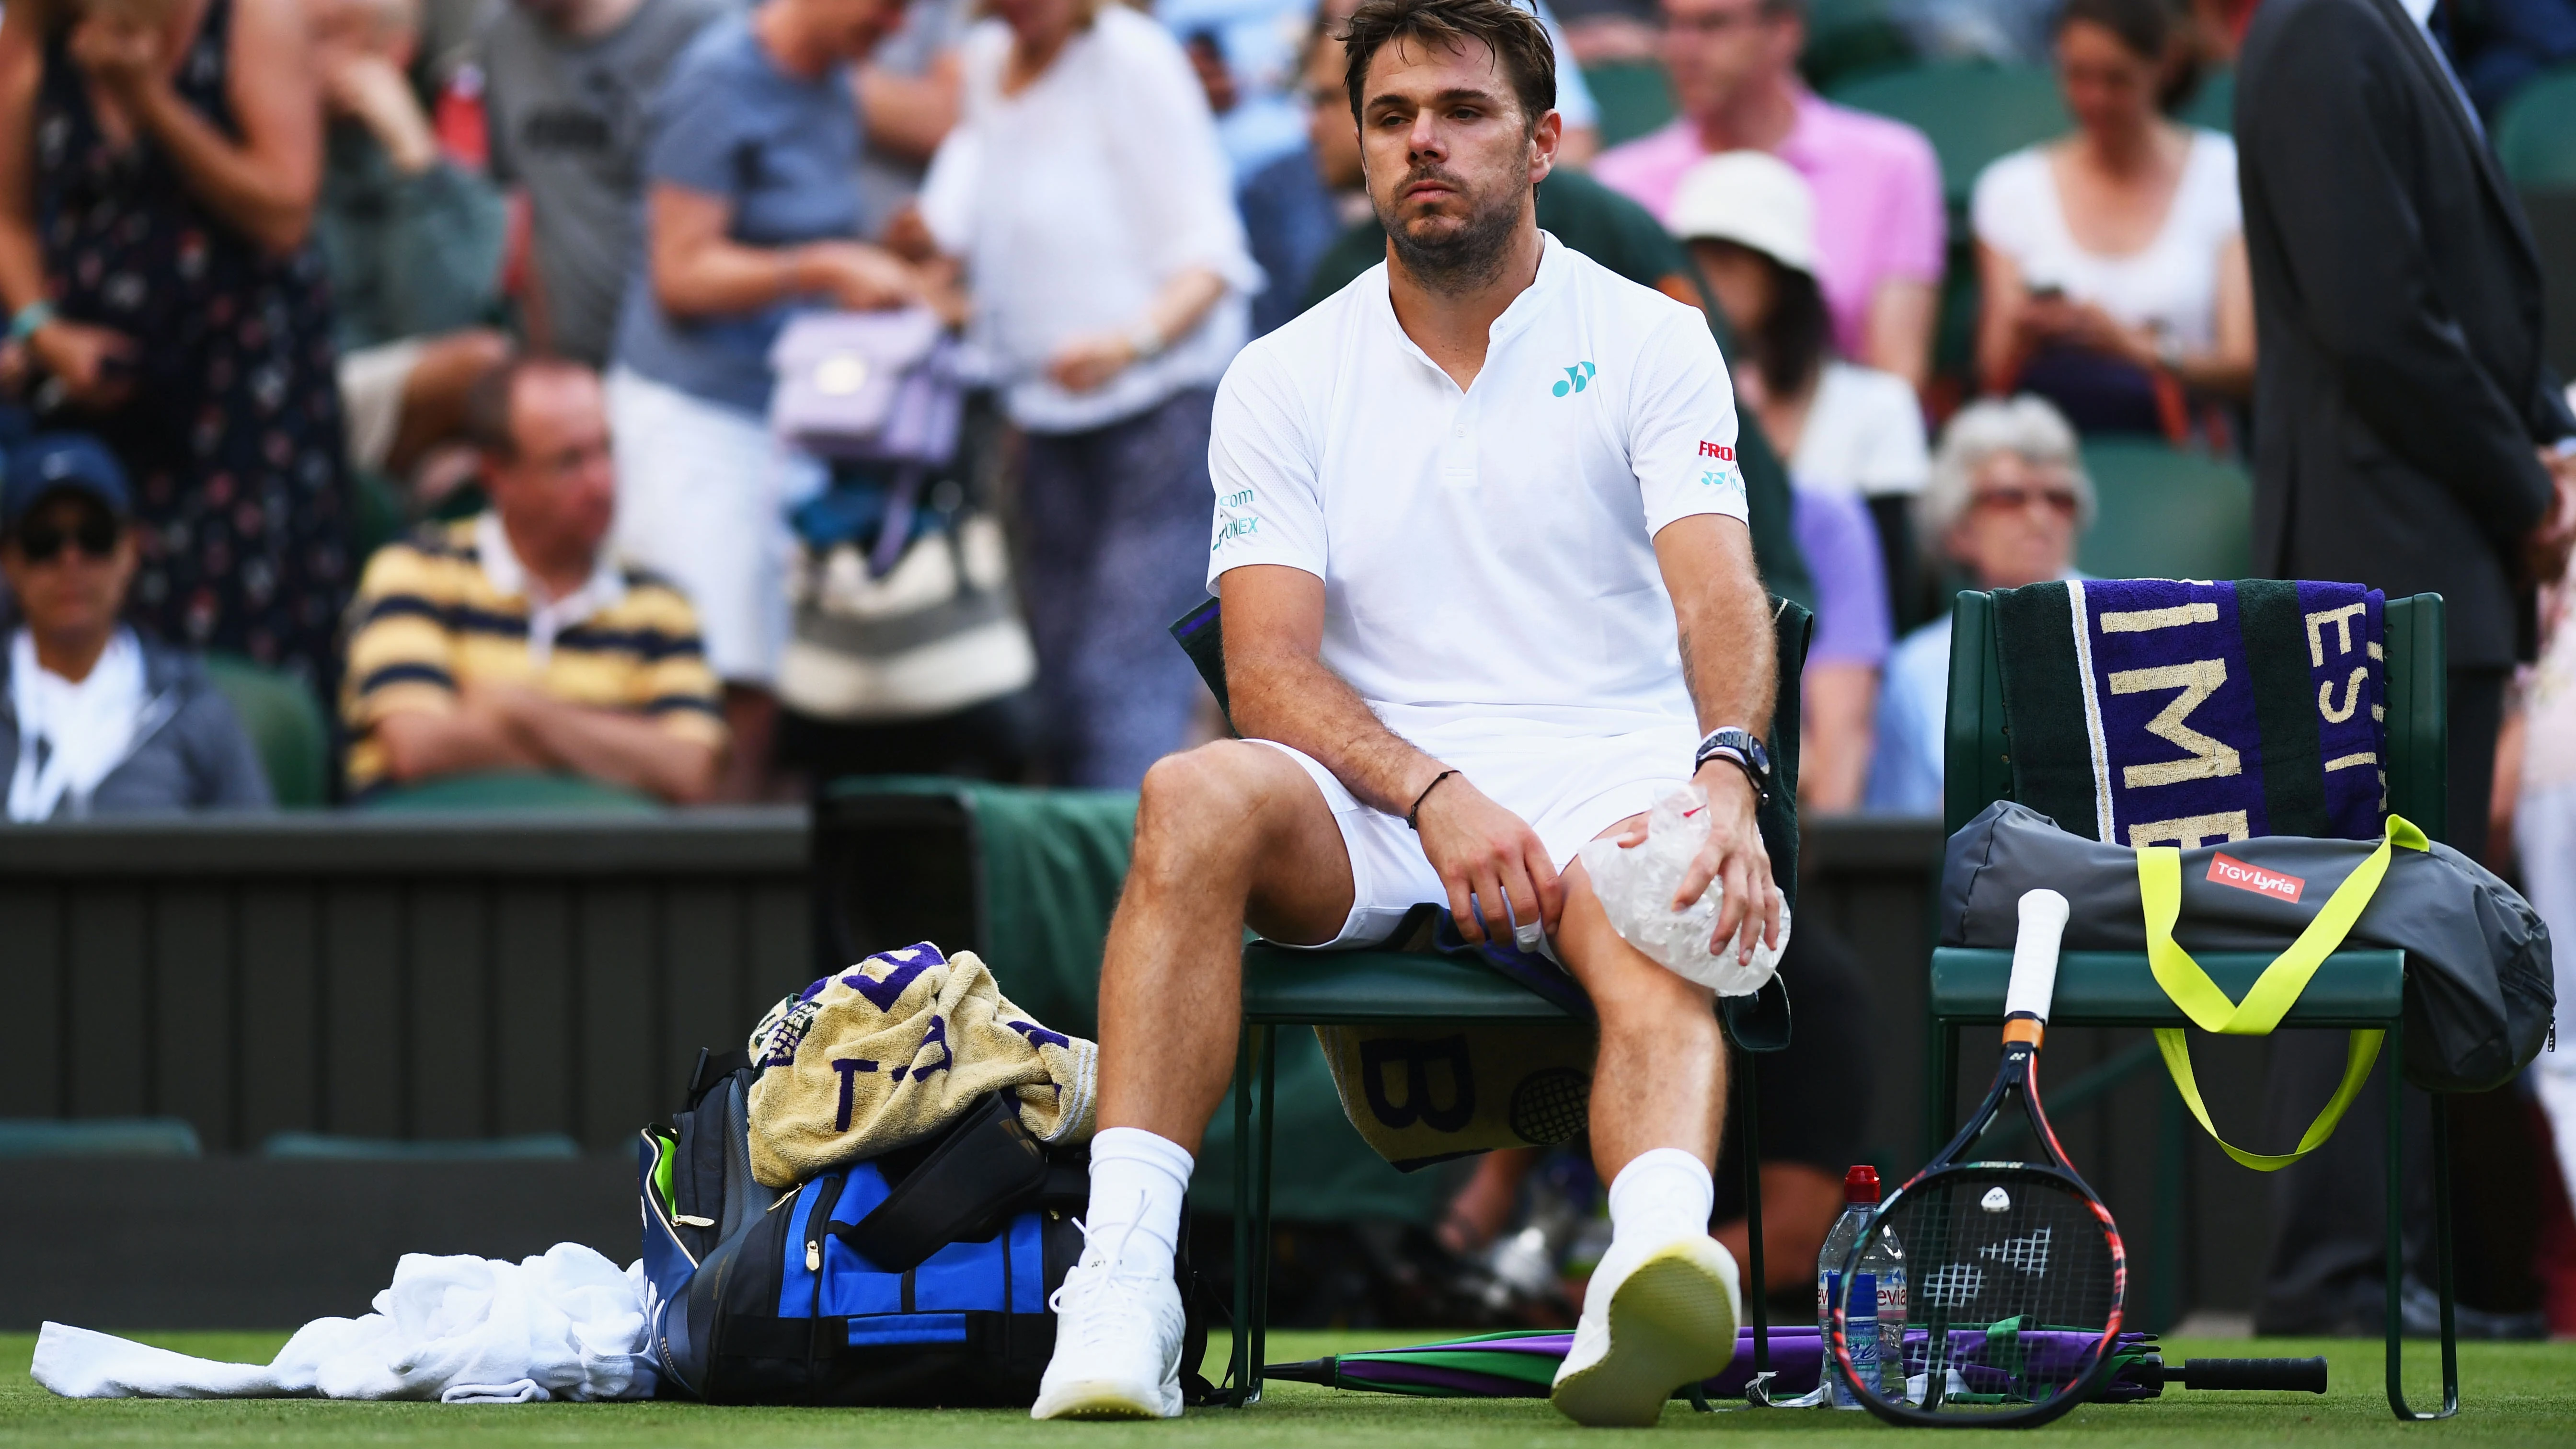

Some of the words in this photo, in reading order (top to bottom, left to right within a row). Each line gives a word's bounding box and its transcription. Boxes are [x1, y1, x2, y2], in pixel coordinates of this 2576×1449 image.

[1699, 440, 1736, 461] FRO
[2218, 862, 2254, 882] TGV
[2253, 871, 2296, 895] Lyria
[1877, 1285, 1907, 1306] evia
